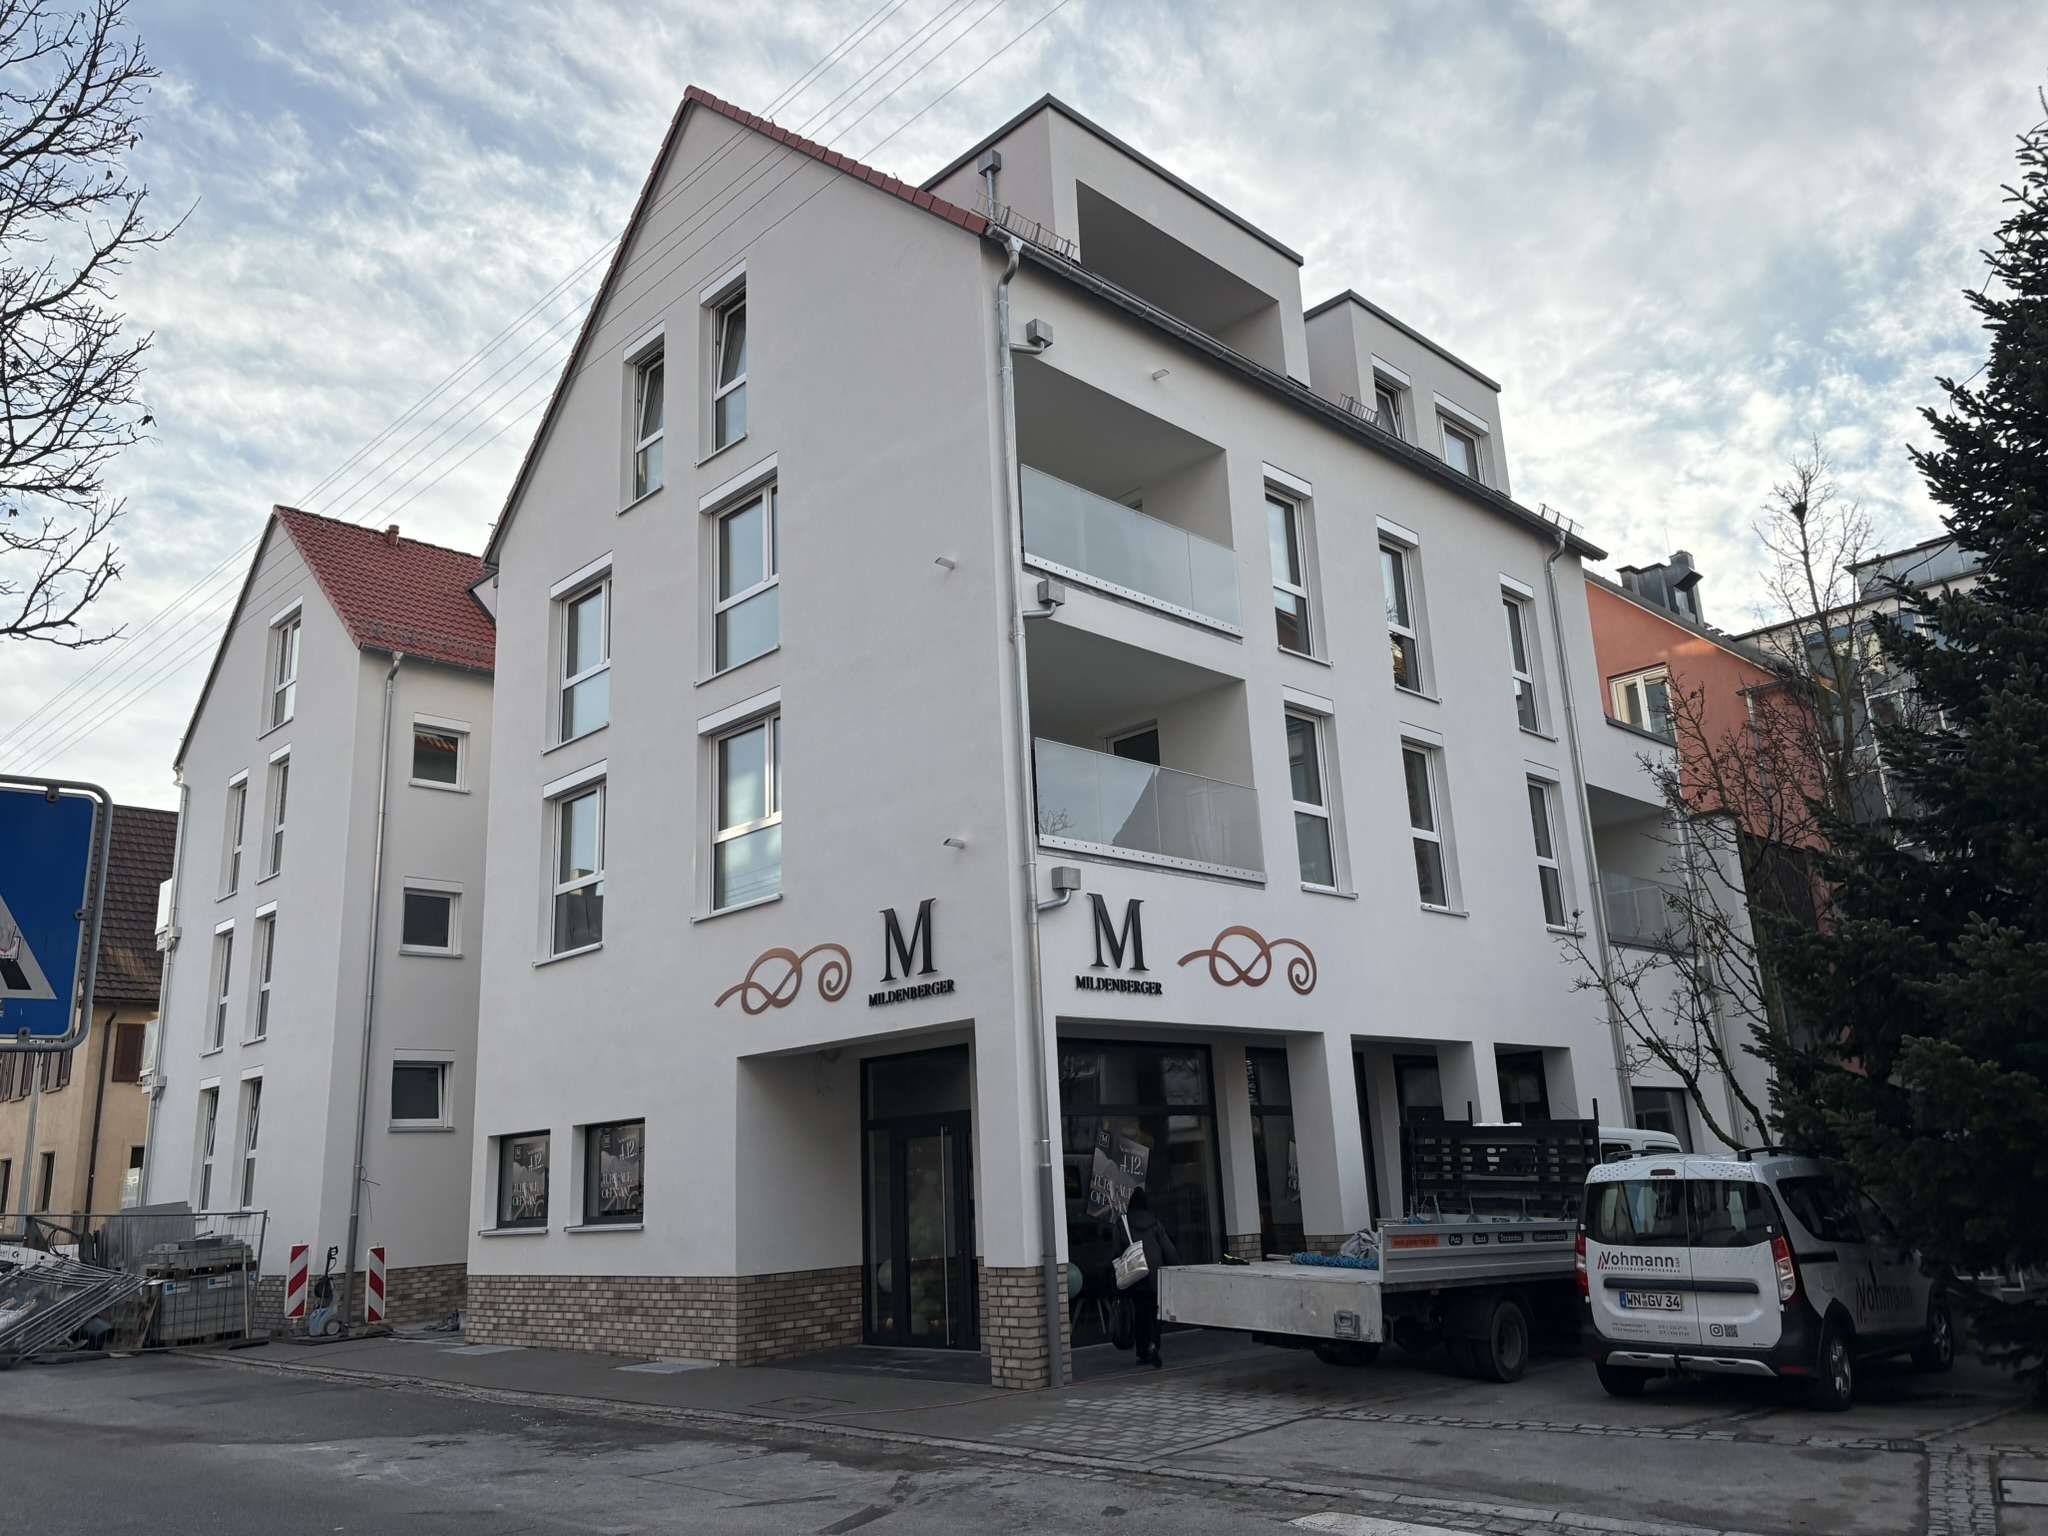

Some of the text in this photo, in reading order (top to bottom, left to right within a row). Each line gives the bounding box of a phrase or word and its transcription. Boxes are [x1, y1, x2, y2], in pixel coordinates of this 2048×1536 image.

[880, 897, 939, 983] M
[1086, 892, 1150, 972] M
[868, 979, 955, 1008] MILDENBERGER
[1075, 975, 1163, 996] MILDENBERGER
[1627, 1292, 1680, 1309] WN GV 34
